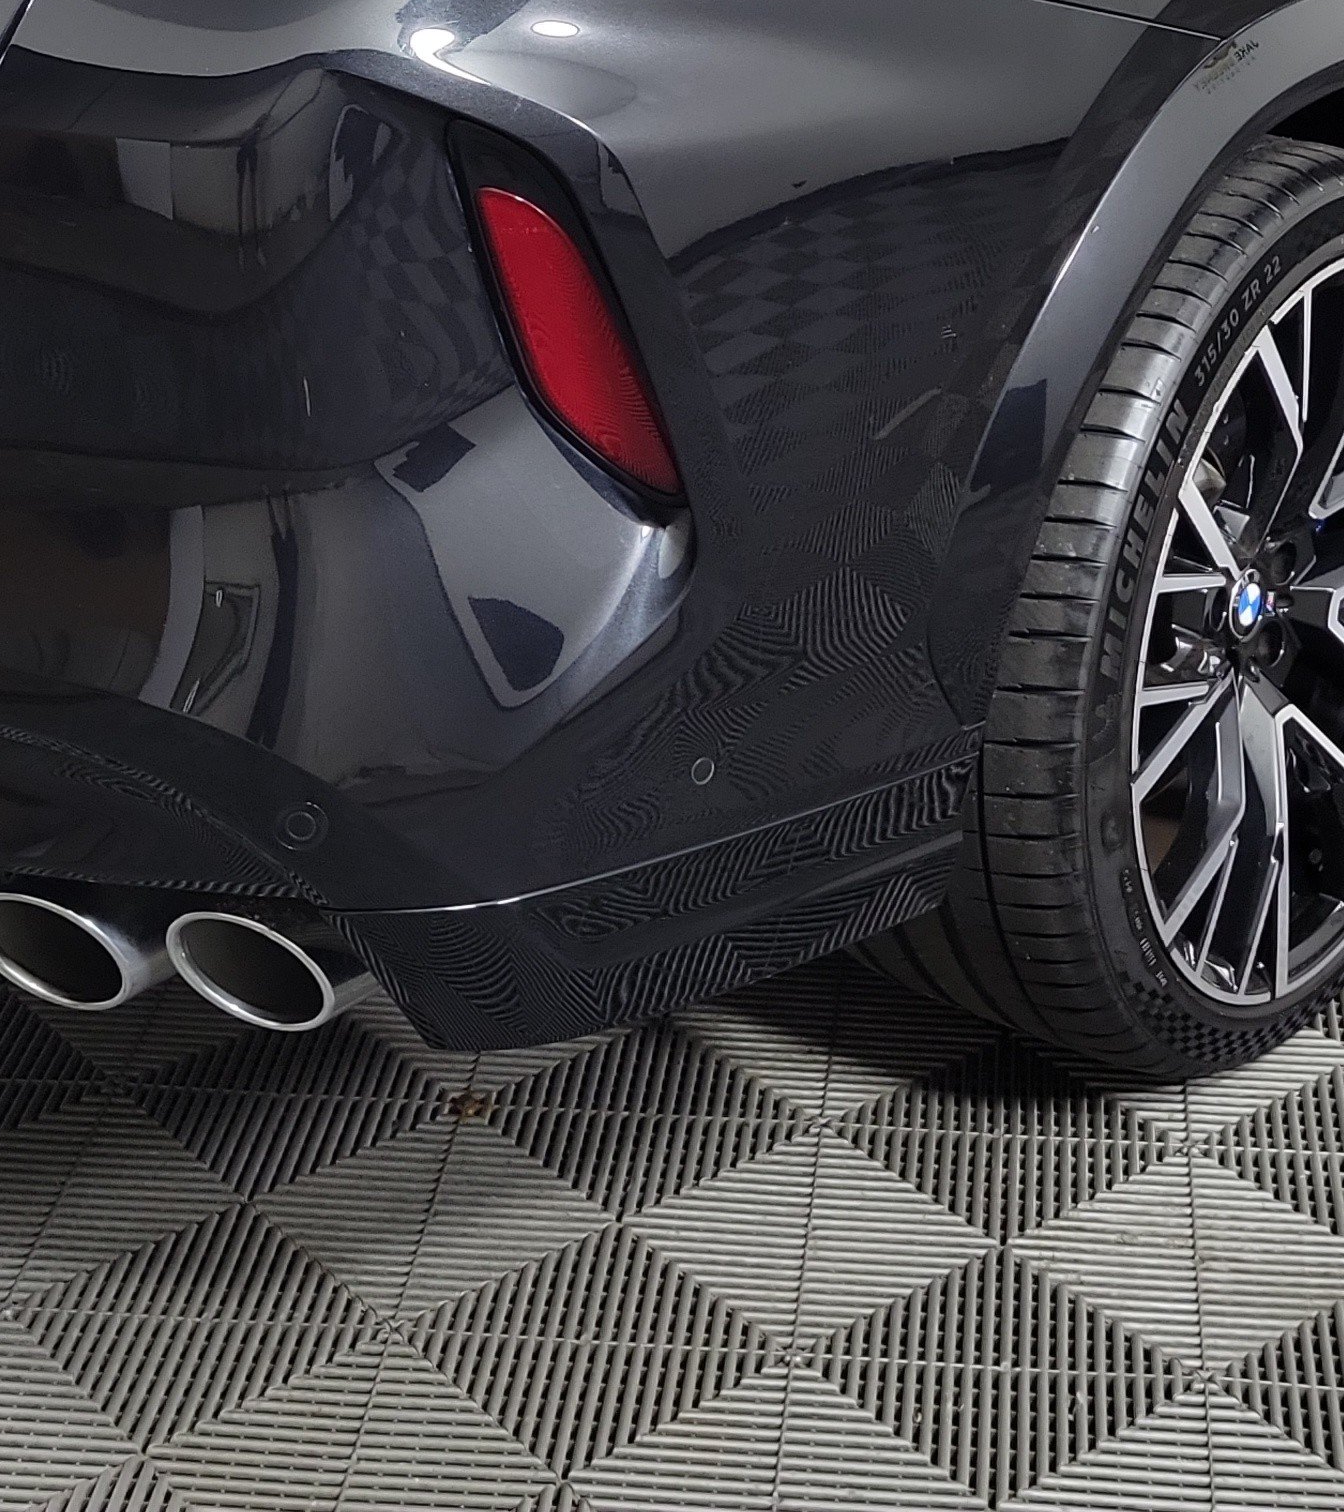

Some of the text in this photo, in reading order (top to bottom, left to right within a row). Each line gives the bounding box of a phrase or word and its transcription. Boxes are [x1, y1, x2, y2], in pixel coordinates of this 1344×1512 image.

[1100, 255, 1282, 681] MICHELIN 315/30 ZR 22
